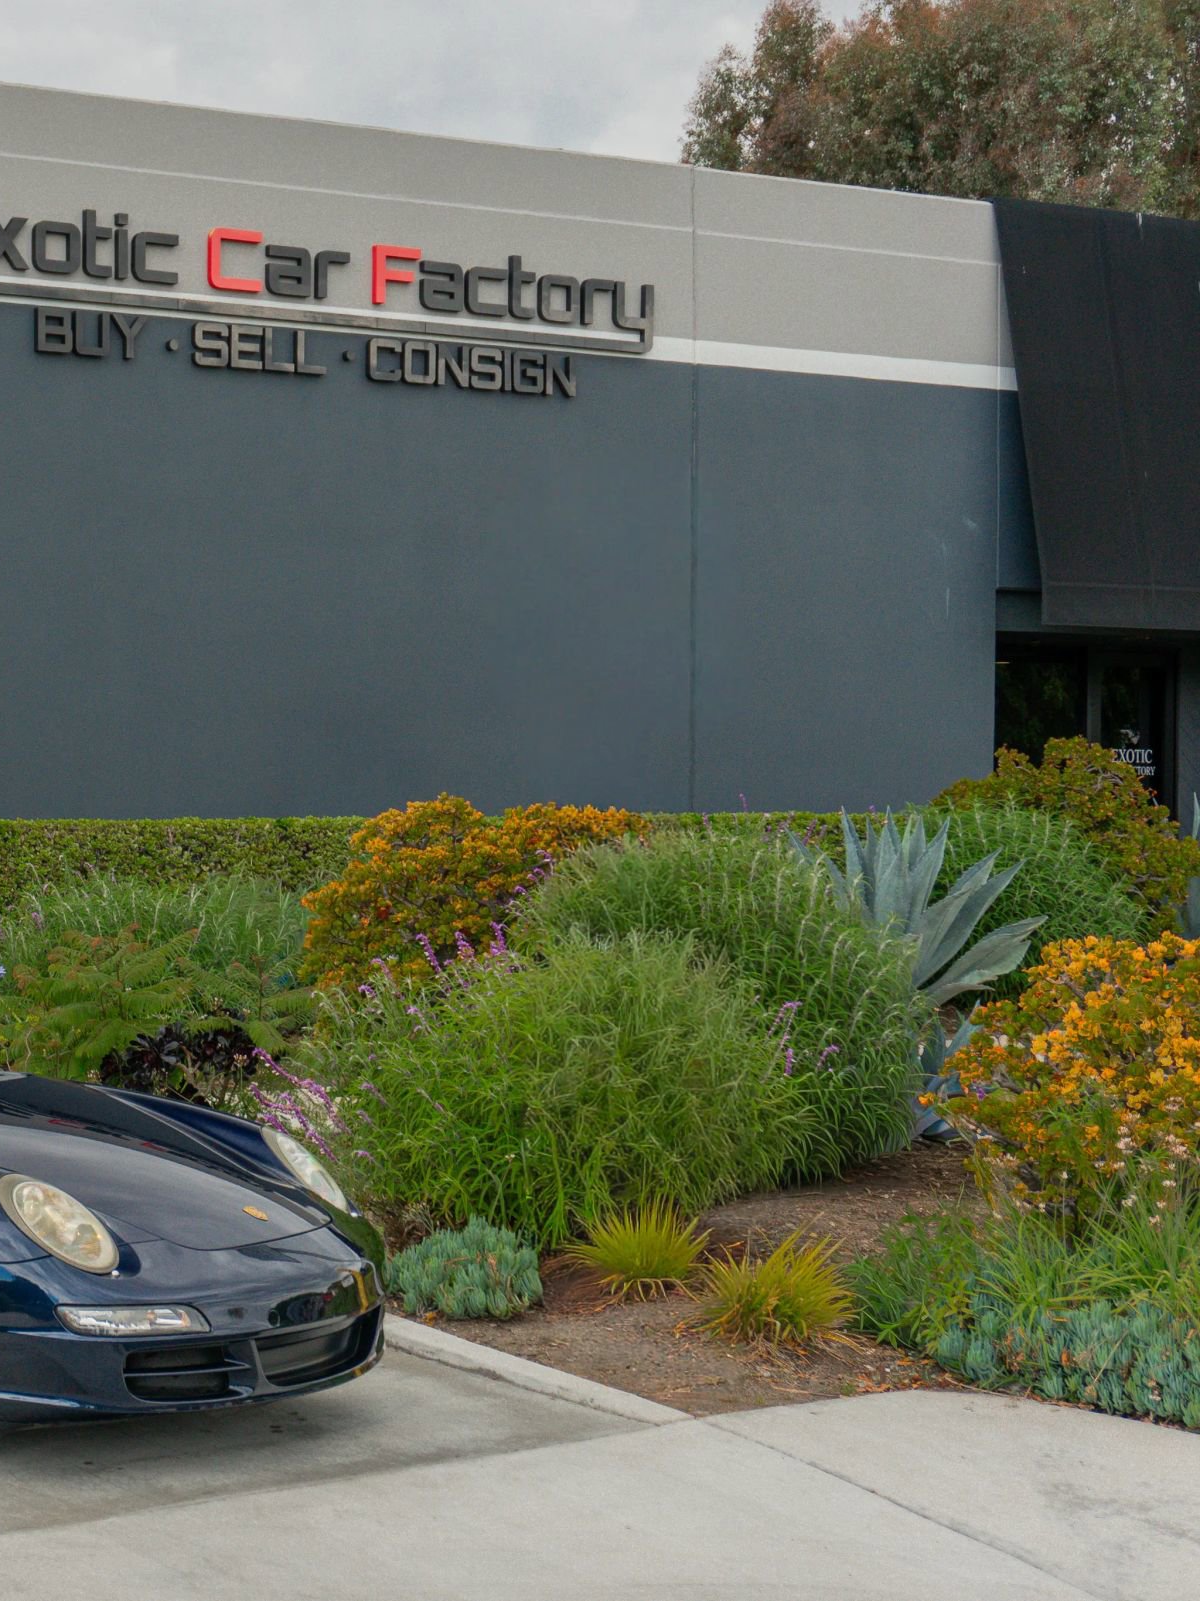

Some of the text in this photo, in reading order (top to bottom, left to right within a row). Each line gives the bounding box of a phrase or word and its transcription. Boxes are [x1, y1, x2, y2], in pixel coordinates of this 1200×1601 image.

[207, 227, 350, 299] Car
[371, 244, 655, 353] Factory
[34, 306, 577, 397] BUY SELL CONSIGN
